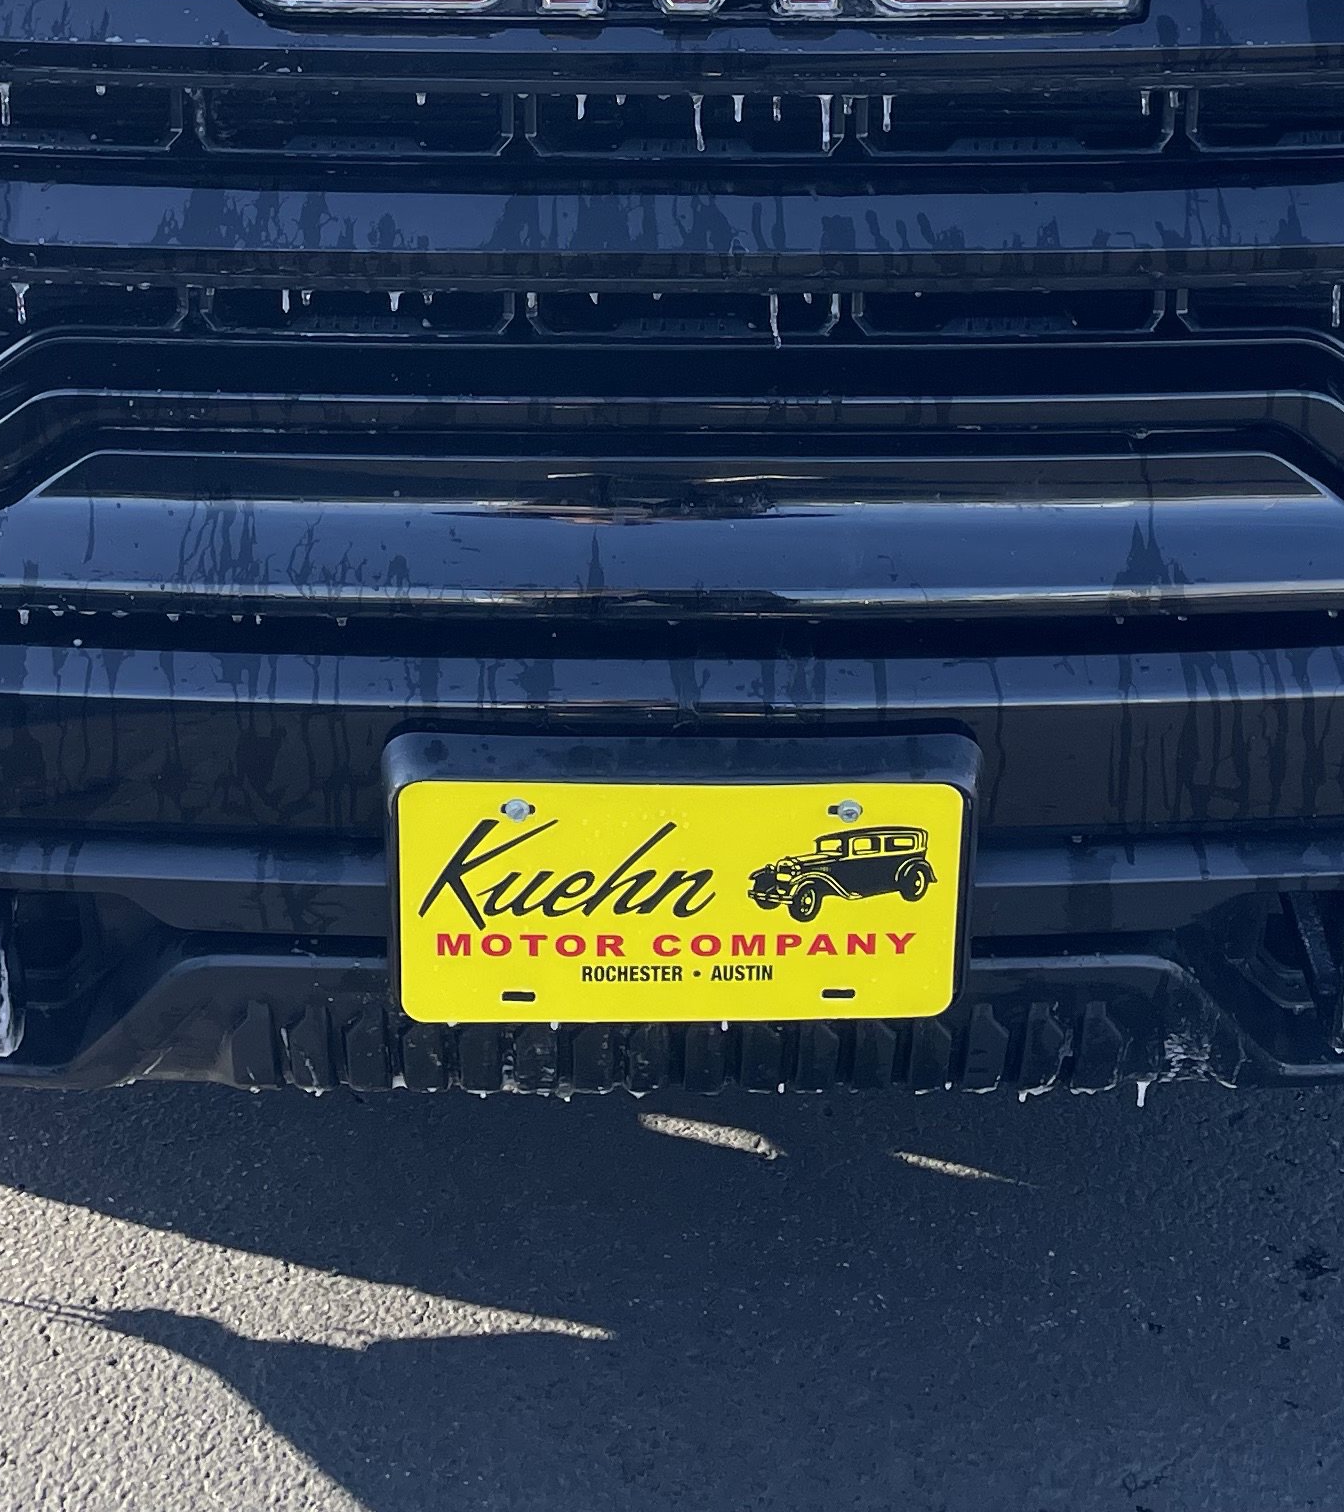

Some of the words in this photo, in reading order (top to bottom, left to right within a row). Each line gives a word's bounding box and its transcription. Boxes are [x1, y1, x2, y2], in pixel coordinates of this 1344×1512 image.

[418, 819, 716, 931] Kuehn
[437, 934, 626, 957] MOTOR
[652, 932, 918, 957] COMPANY
[581, 964, 684, 983] ROCHESTER
[710, 964, 774, 982] AUSTIN
